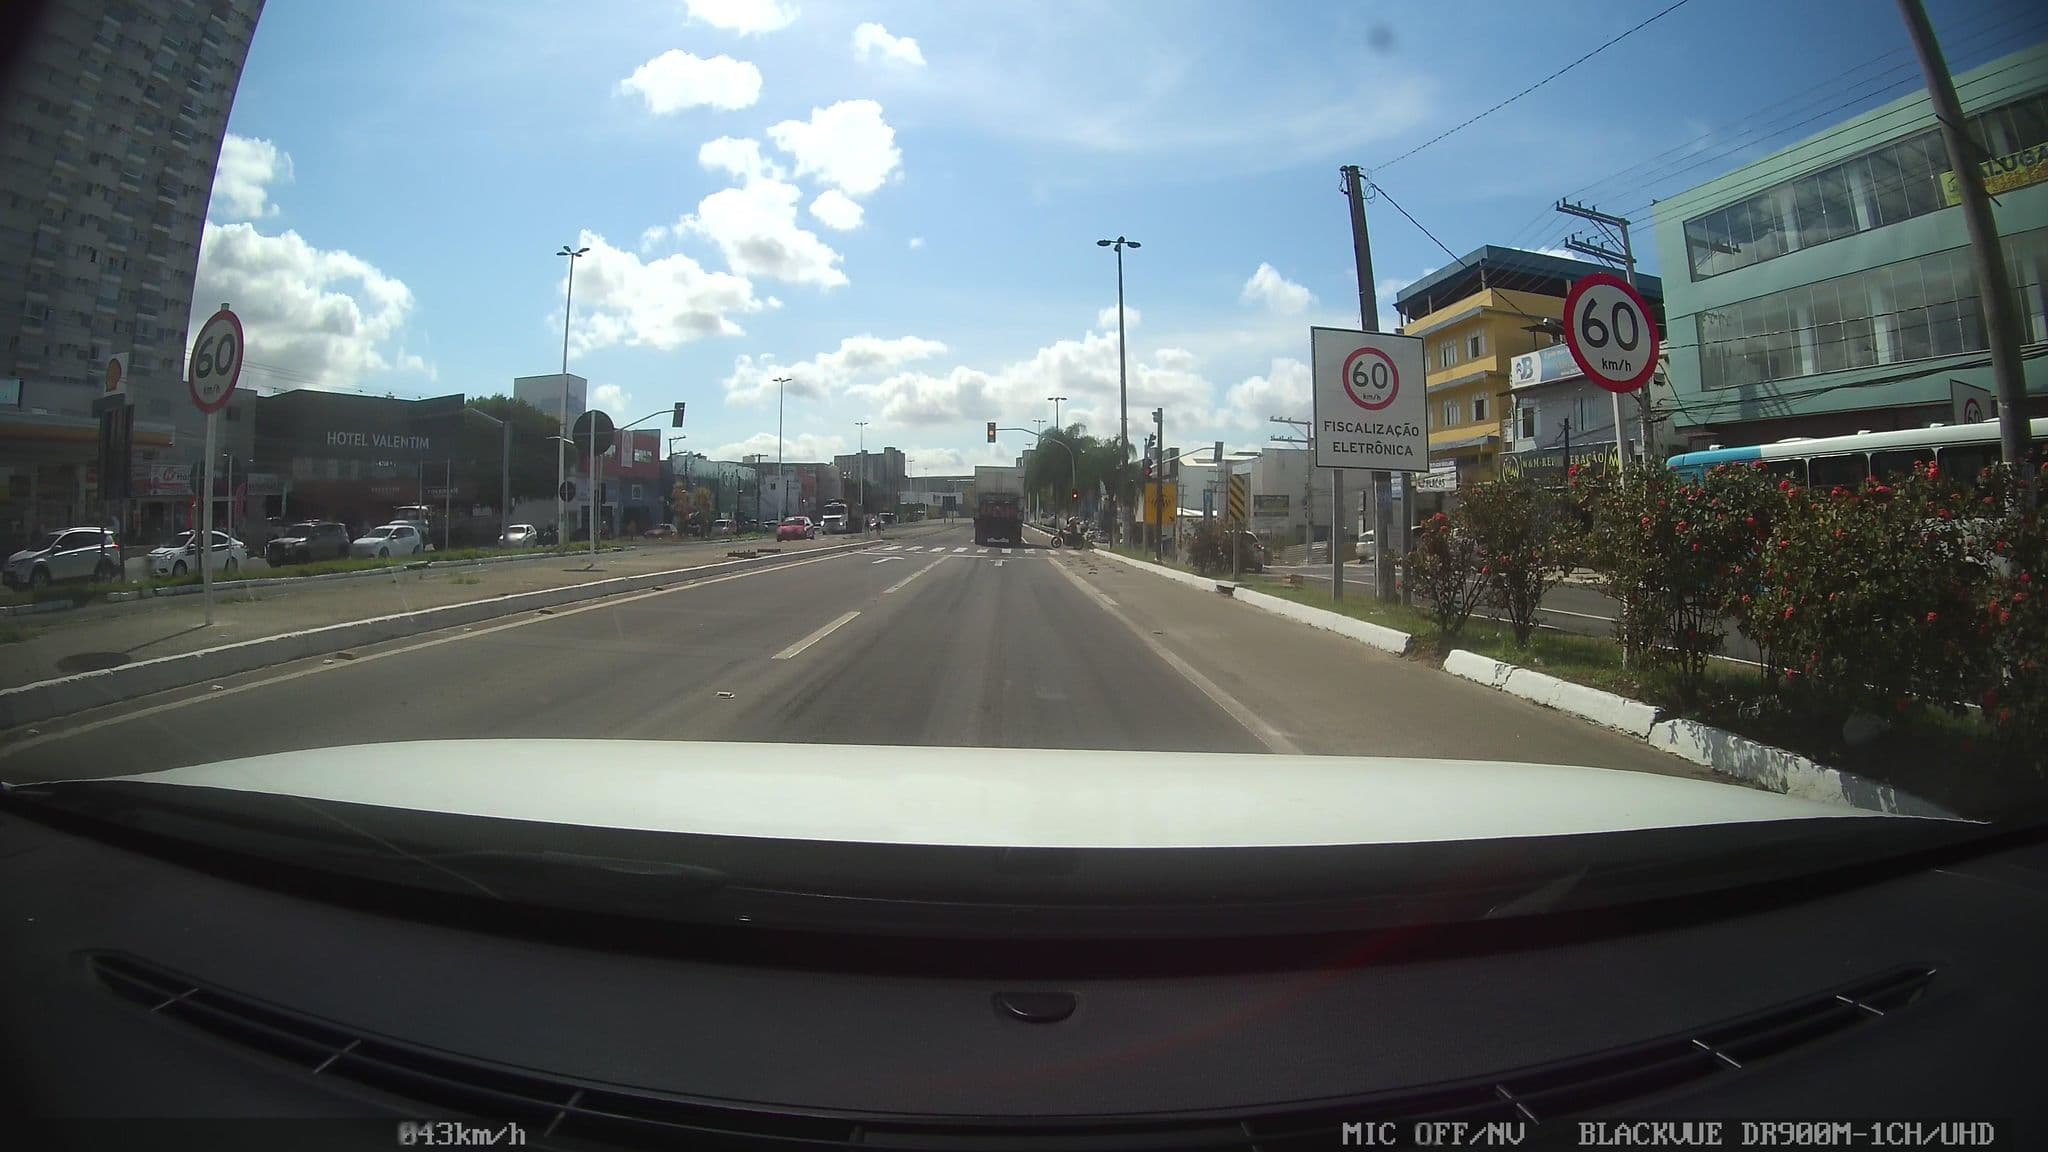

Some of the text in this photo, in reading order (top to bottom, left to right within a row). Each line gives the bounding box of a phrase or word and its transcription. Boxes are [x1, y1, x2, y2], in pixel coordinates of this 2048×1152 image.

[1582, 298, 1639, 351] 60
[195, 334, 235, 378] 60
[1602, 358, 1631, 372] km/h
[1352, 361, 1388, 389] 60
[1362, 393, 1381, 401] km/h
[1324, 420, 1419, 437] FISCALIZAÇÃO
[327, 431, 430, 449] HOTEL VALENTIM
[1333, 441, 1413, 456] ELETRÔNICA
